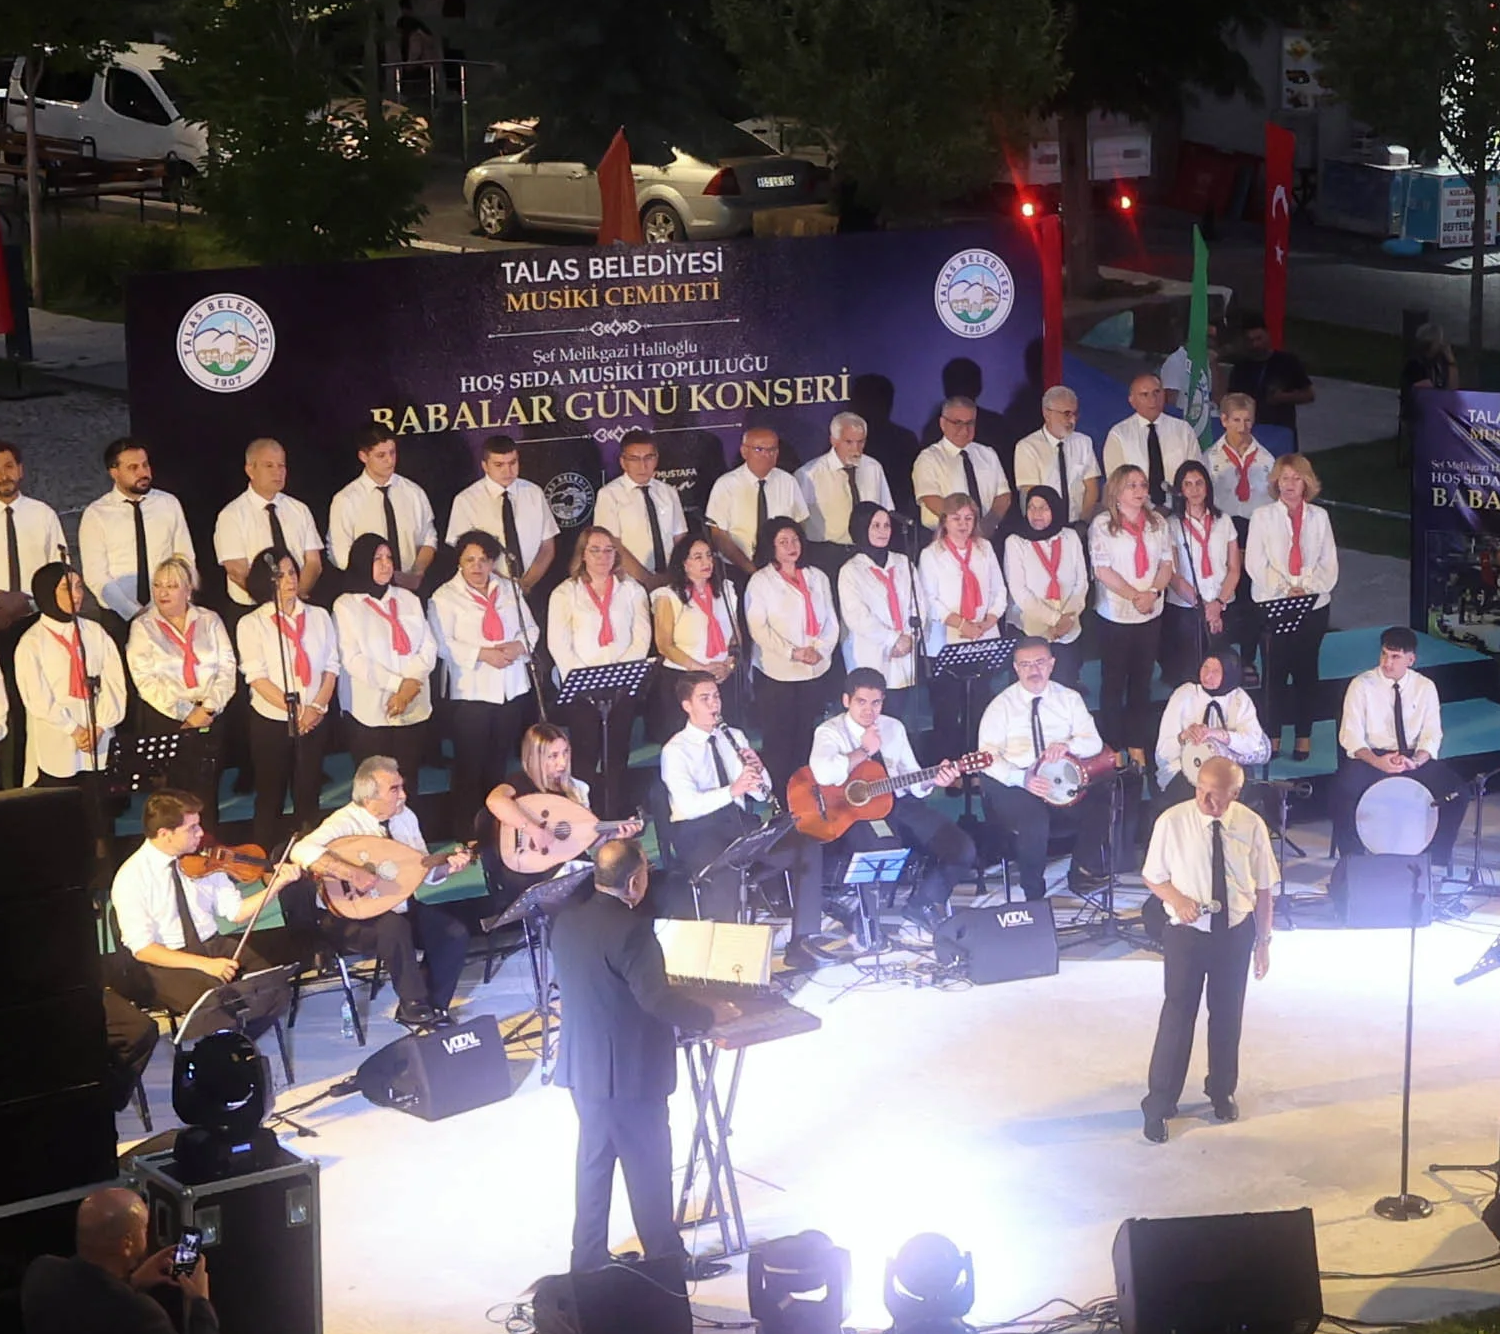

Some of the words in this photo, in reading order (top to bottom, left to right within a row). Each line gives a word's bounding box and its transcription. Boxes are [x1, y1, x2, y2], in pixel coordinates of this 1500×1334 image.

[501, 258, 579, 284] TALAS
[589, 247, 723, 280] BELEDİYESİ
[504, 283, 598, 313] MUSİKİ
[605, 277, 720, 306] CEMİYETİ
[964, 323, 986, 332] 1907
[532, 349, 555, 366] Şef
[559, 343, 628, 364] Melikgazi
[633, 339, 698, 359] Haliloğlu
[214, 375, 242, 386] 1907
[459, 374, 505, 396] HOŞ
[509, 370, 564, 389] SEDA
[569, 364, 643, 385] MUSİKİ
[648, 355, 769, 379] TOPLULUĞU
[370, 395, 556, 436] BABALAR
[566, 381, 680, 421] GÜNÜ
[688, 367, 851, 413] KONSERİ
[1463, 474, 1500, 487] SEDA
